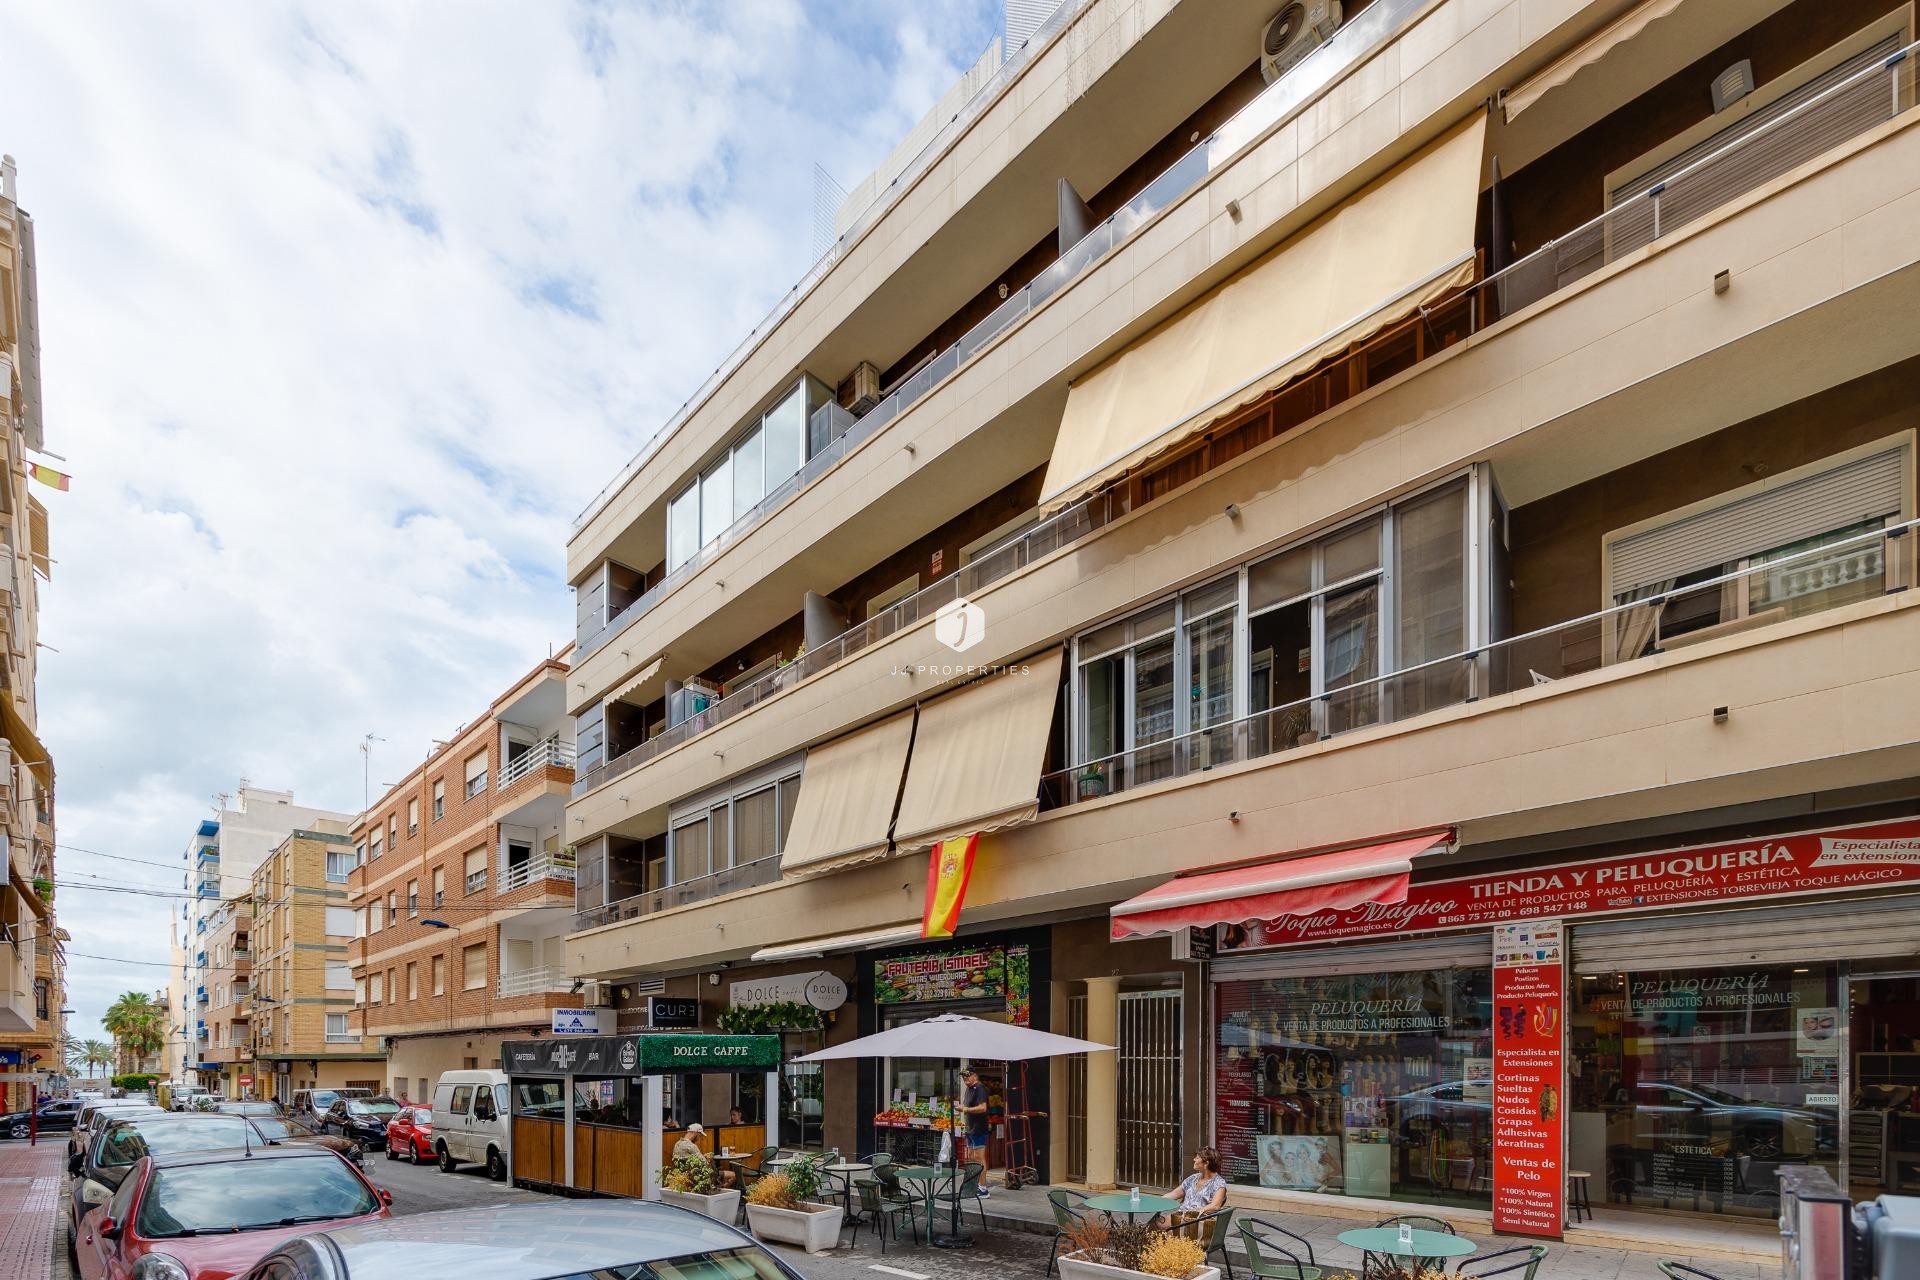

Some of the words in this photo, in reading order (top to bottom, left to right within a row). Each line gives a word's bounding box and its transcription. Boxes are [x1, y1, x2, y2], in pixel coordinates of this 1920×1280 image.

[1470, 874, 1564, 898] TIENDA
[1570, 871, 1589, 886] Y
[1596, 843, 1794, 884] PELUQUERÍA
[1466, 901, 1500, 912] VENTA
[1502, 898, 1516, 908] DE
[1520, 890, 1591, 906] PRODUCTOS
[1597, 886, 1627, 897] PARA
[1634, 874, 1714, 893] PELUQUERÍA
[1720, 874, 1730, 883] Y
[1737, 866, 1800, 882] ESTÉTICA
[1646, 888, 1719, 903] EXTENSIONES
[1722, 881, 1790, 894] TORREVIEJA
[1794, 874, 1841, 887] TOQUE
[1844, 868, 1903, 882] MÁGICO
[1447, 914, 1466, 924] 865
[1468, 912, 1480, 921] 75
[1483, 911, 1496, 920] 72
[1498, 909, 1511, 918] 00
[1520, 906, 1540, 916] 698
[1543, 904, 1563, 913] 547
[1566, 901, 1588, 910] 148
[1266, 912, 1338, 938] Toque
[1346, 899, 1458, 930] Mágico
[1307, 923, 1393, 937] www.toquemagico.es
[888, 959, 940, 977] FRUTERIA
[943, 953, 988, 971] ISMAEL
[813, 984, 841, 994] DOLCE
[1632, 973, 1769, 996] PELUQUERÍA
[747, 985, 780, 1002] DOLCE
[1311, 995, 1424, 1018] PELUQUERÍA
[1600, 1000, 1632, 1010] VENTA
[1633, 1000, 1645, 1009] DE
[1647, 996, 1703, 1009] PRODUCTOS
[1706, 996, 1713, 1007] A
[1716, 992, 1800, 1007] PROFESIONALES
[1284, 1020, 1308, 1032] VENTA
[1310, 1020, 1320, 1030] DE
[1322, 1018, 1369, 1030] PRODUCTOS
[1371, 1018, 1377, 1029] A
[1379, 1016, 1450, 1029] PROFESIONALES
[588, 1052, 600, 1060] BAR
[674, 1046, 708, 1056] DOLCE
[714, 1046, 748, 1056] CAFFE
[1497, 1048, 1546, 1058] Especialista
[1497, 1074, 1540, 1082] Cortinas
[1497, 1084, 1533, 1093] Sueltas
[1497, 1096, 1530, 1104] Nudos
[1497, 1106, 1537, 1115] Cosidas
[1497, 1118, 1533, 1127] Grapas
[1497, 1128, 1548, 1138] Adhesivas
[1497, 1140, 1545, 1149] Keratinas
[1502, 1156, 1539, 1168] Ventas
[1542, 1158, 1556, 1168] de
[1517, 1170, 1541, 1181] Pelo
[1526, 1189, 1552, 1198] Virgen
[1525, 1199, 1554, 1208] Natural
[1523, 1208, 1556, 1219] Sintético
[1502, 1216, 1521, 1225] Semi
[1522, 1219, 1550, 1228] Natural
